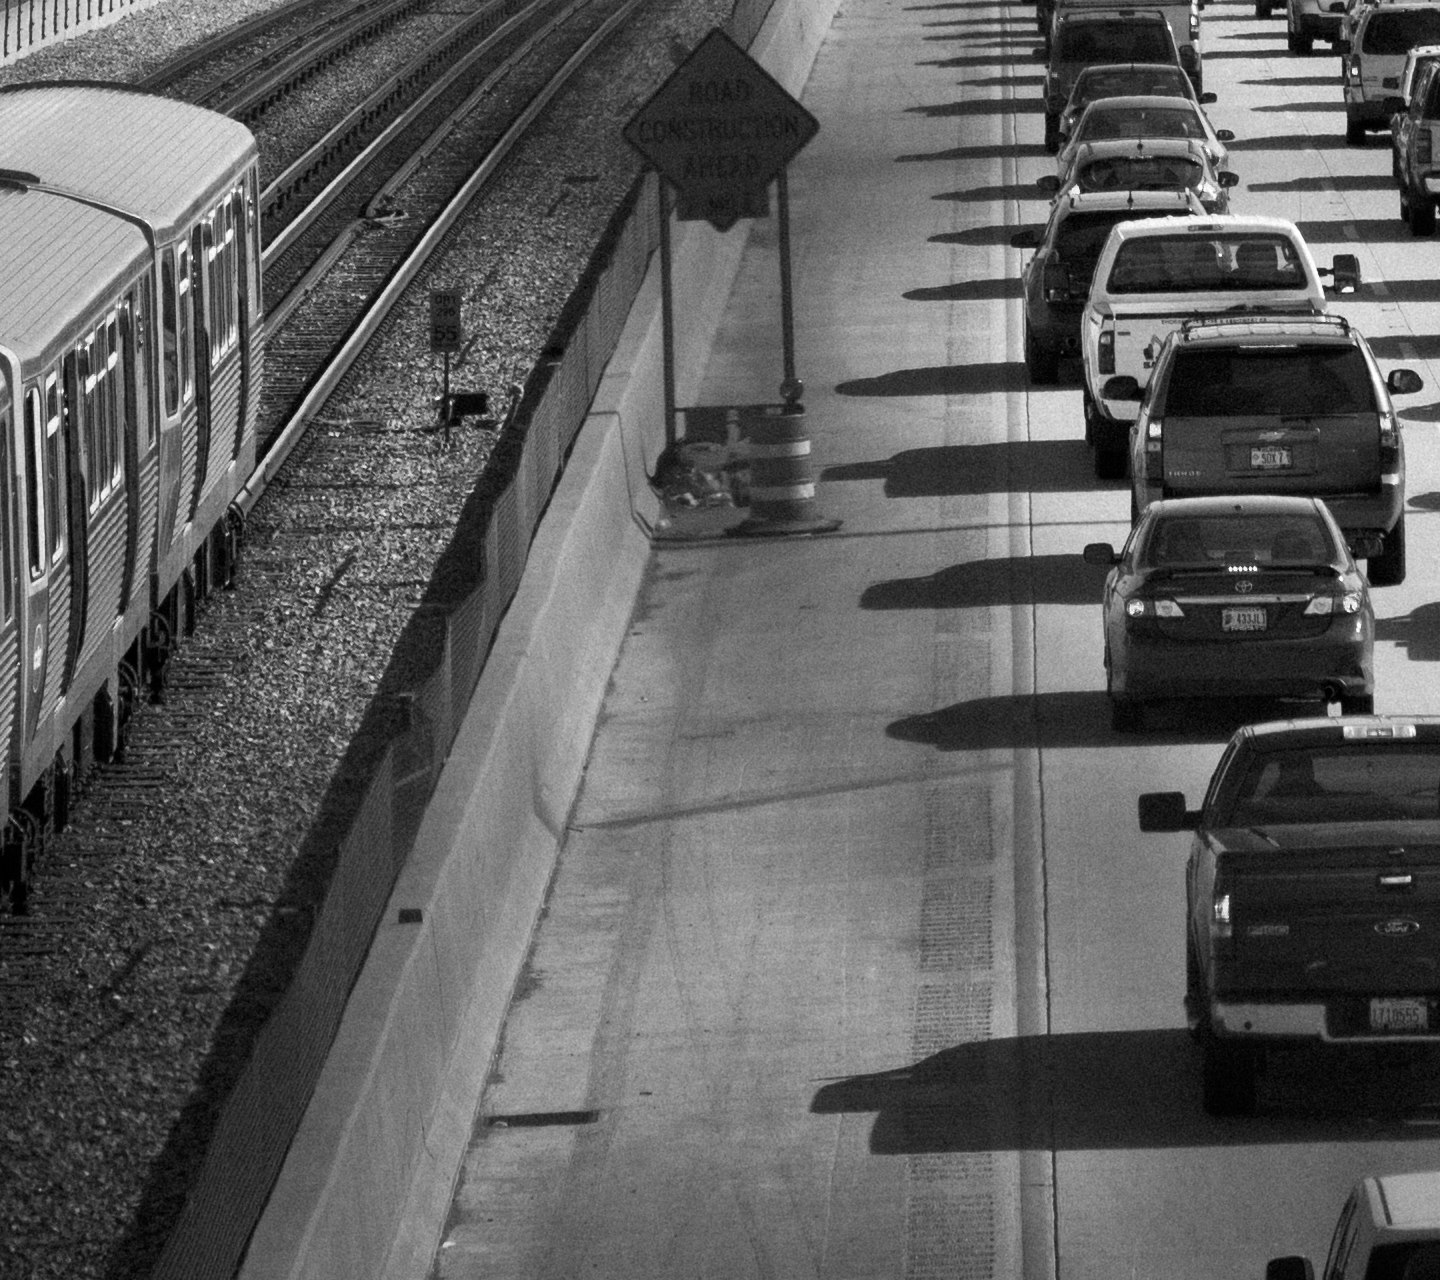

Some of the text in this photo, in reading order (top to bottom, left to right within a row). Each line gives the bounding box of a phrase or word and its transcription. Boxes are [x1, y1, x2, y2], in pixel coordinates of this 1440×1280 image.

[689, 80, 751, 104] ROAD
[639, 115, 800, 144] CONSTRUCTION
[683, 155, 760, 179] AHEAD
